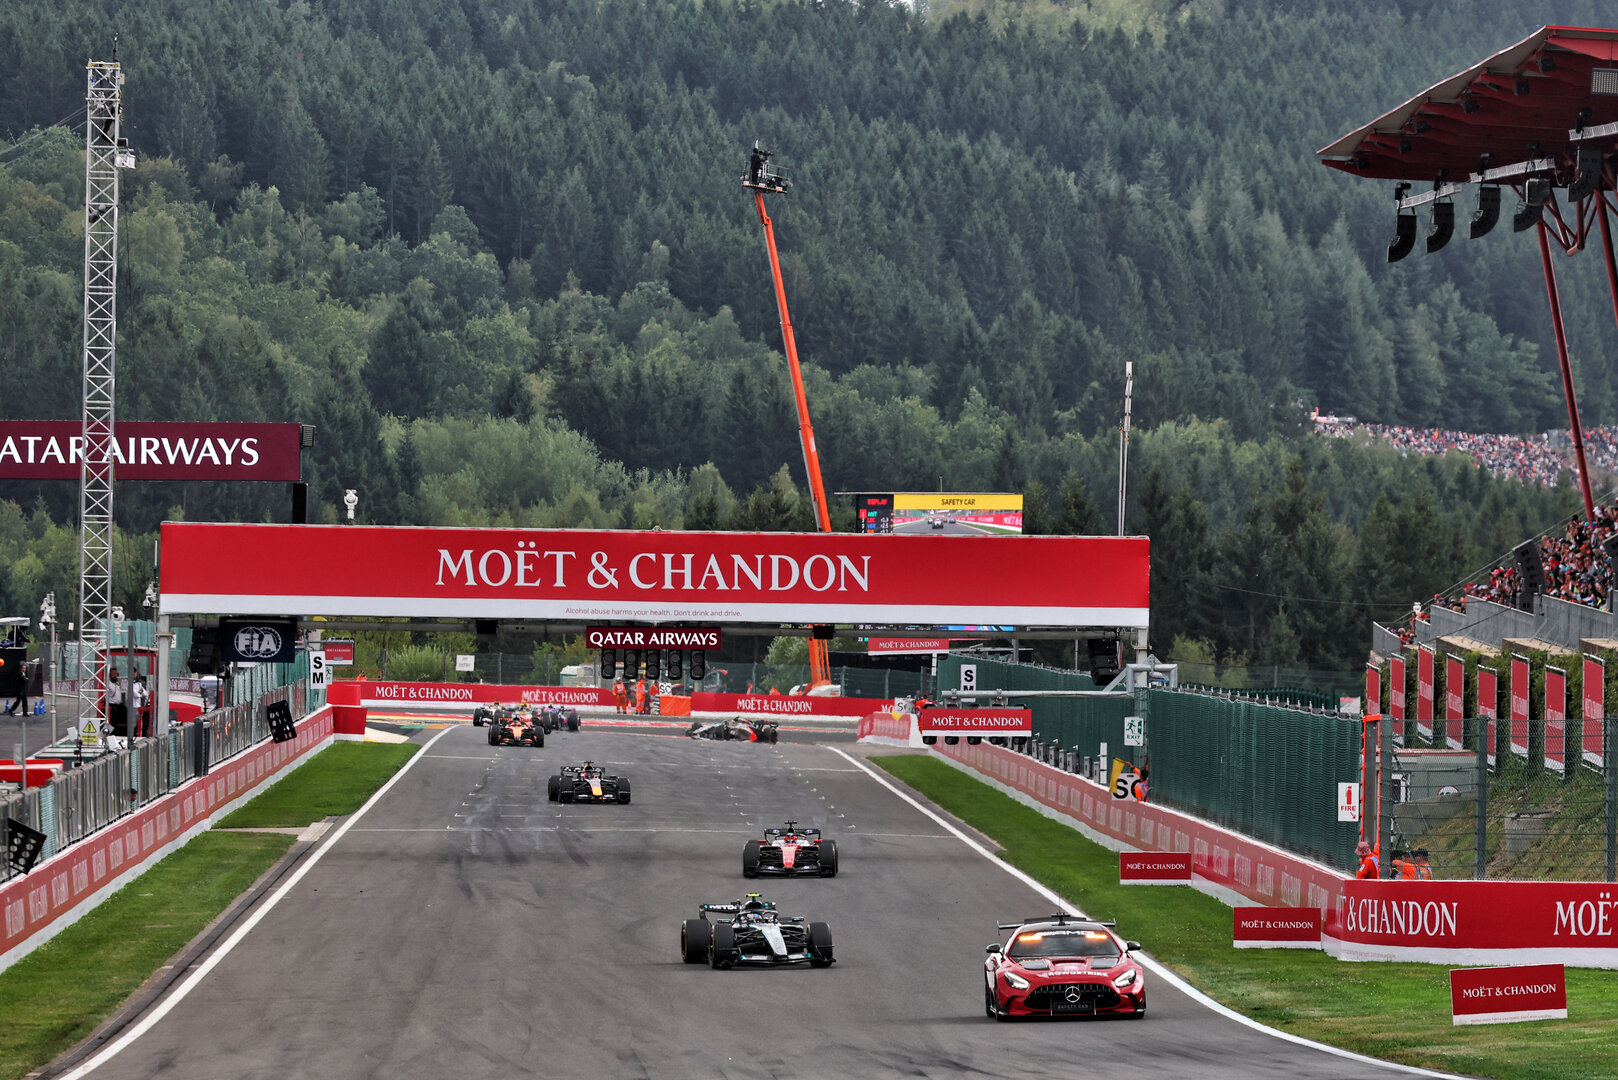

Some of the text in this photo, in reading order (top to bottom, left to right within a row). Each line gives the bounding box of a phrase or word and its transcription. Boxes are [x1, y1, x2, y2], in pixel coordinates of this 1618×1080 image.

[104, 438, 260, 466] AIRWAYS
[941, 498, 963, 506] SAFETY
[435, 540, 872, 592] MOËT & CHANDON
[589, 631, 718, 648] QATAR AIRWAYS
[879, 640, 940, 649] MOËT & CHANDON
[313, 656, 323, 669] S
[312, 672, 324, 684] M
[964, 670, 974, 683] S
[375, 684, 473, 700] MOËT & CHANDON
[659, 684, 672, 694] SC
[522, 690, 599, 703] MOËT & CHANDON
[736, 697, 813, 712] MOËT & CHANDON
[932, 716, 1023, 727] MOËT & CHANDON
[1126, 862, 1145, 870] MOËT
[1347, 895, 1357, 931] &
[1358, 898, 1458, 937] CHANDON
[1241, 920, 1314, 929] MOËT & CHANDON
[1463, 983, 1557, 999] MOËT & CHANDON
